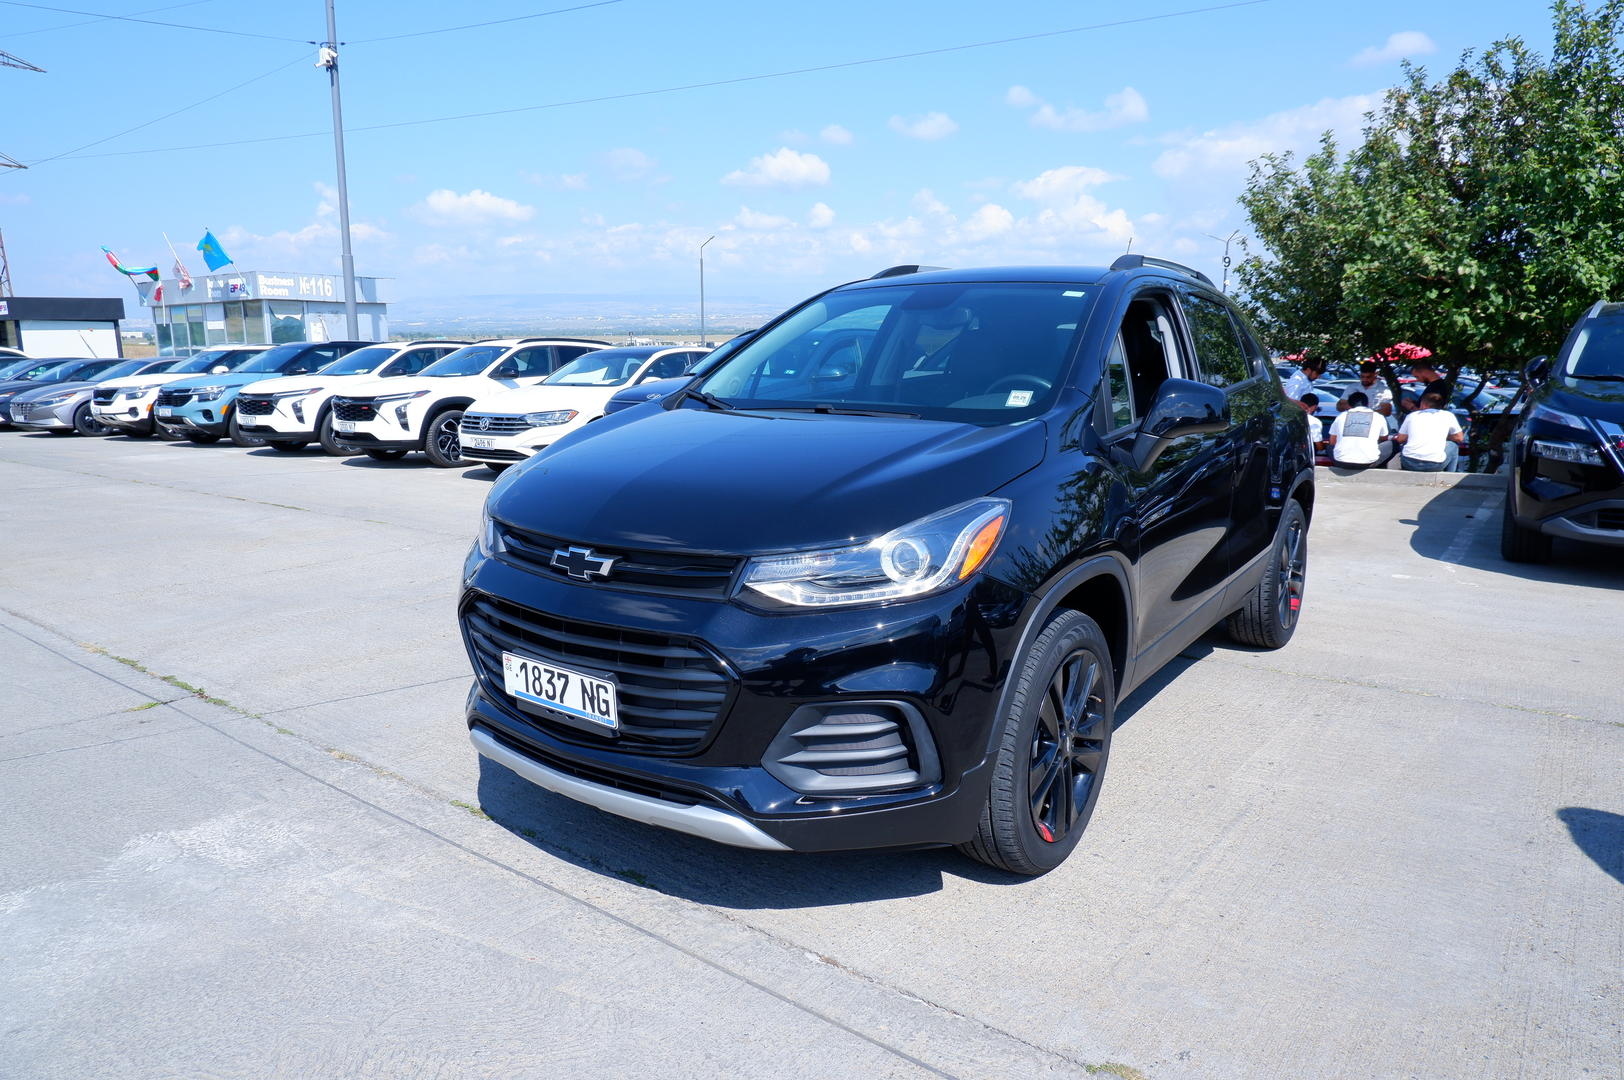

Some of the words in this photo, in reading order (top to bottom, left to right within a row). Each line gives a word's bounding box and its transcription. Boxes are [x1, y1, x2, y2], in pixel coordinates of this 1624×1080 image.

[258, 275, 294, 286] Business
[260, 286, 289, 297] Room
[520, 662, 569, 704] 1837
[580, 678, 610, 717] NG
